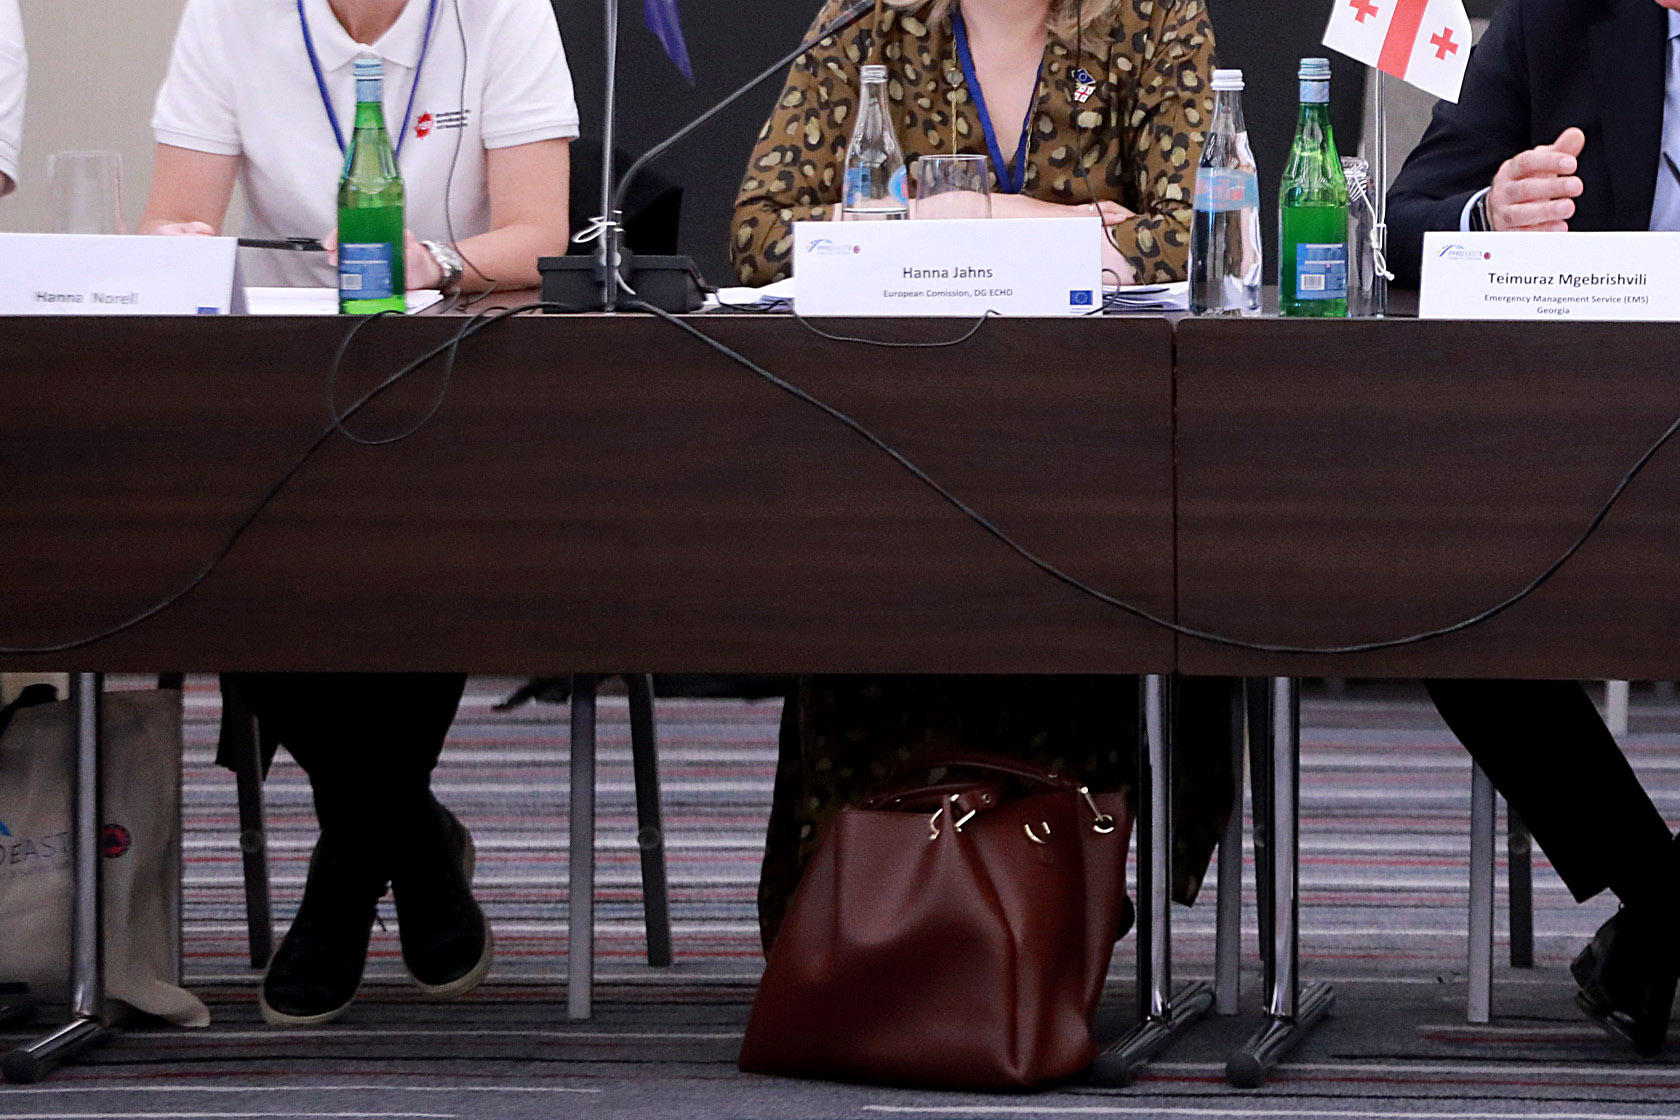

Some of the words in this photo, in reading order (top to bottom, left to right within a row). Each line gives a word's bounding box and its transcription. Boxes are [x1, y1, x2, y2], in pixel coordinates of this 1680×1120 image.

[902, 267, 949, 279] Hanna
[953, 265, 993, 279] Jahns
[1488, 272, 1554, 285] Teimuraz
[1559, 272, 1647, 288] Mgebrishvili
[35, 291, 84, 304] Hanna
[883, 289, 925, 299] European
[926, 289, 973, 299] Comission,
[974, 289, 988, 297] DG
[989, 288, 1014, 297] ECHO
[1484, 293, 1531, 304] Emergency
[1532, 294, 1589, 304] Management
[1591, 294, 1622, 303] Service
[1623, 294, 1649, 305] (EMS)
[1536, 306, 1570, 316] Georgia
